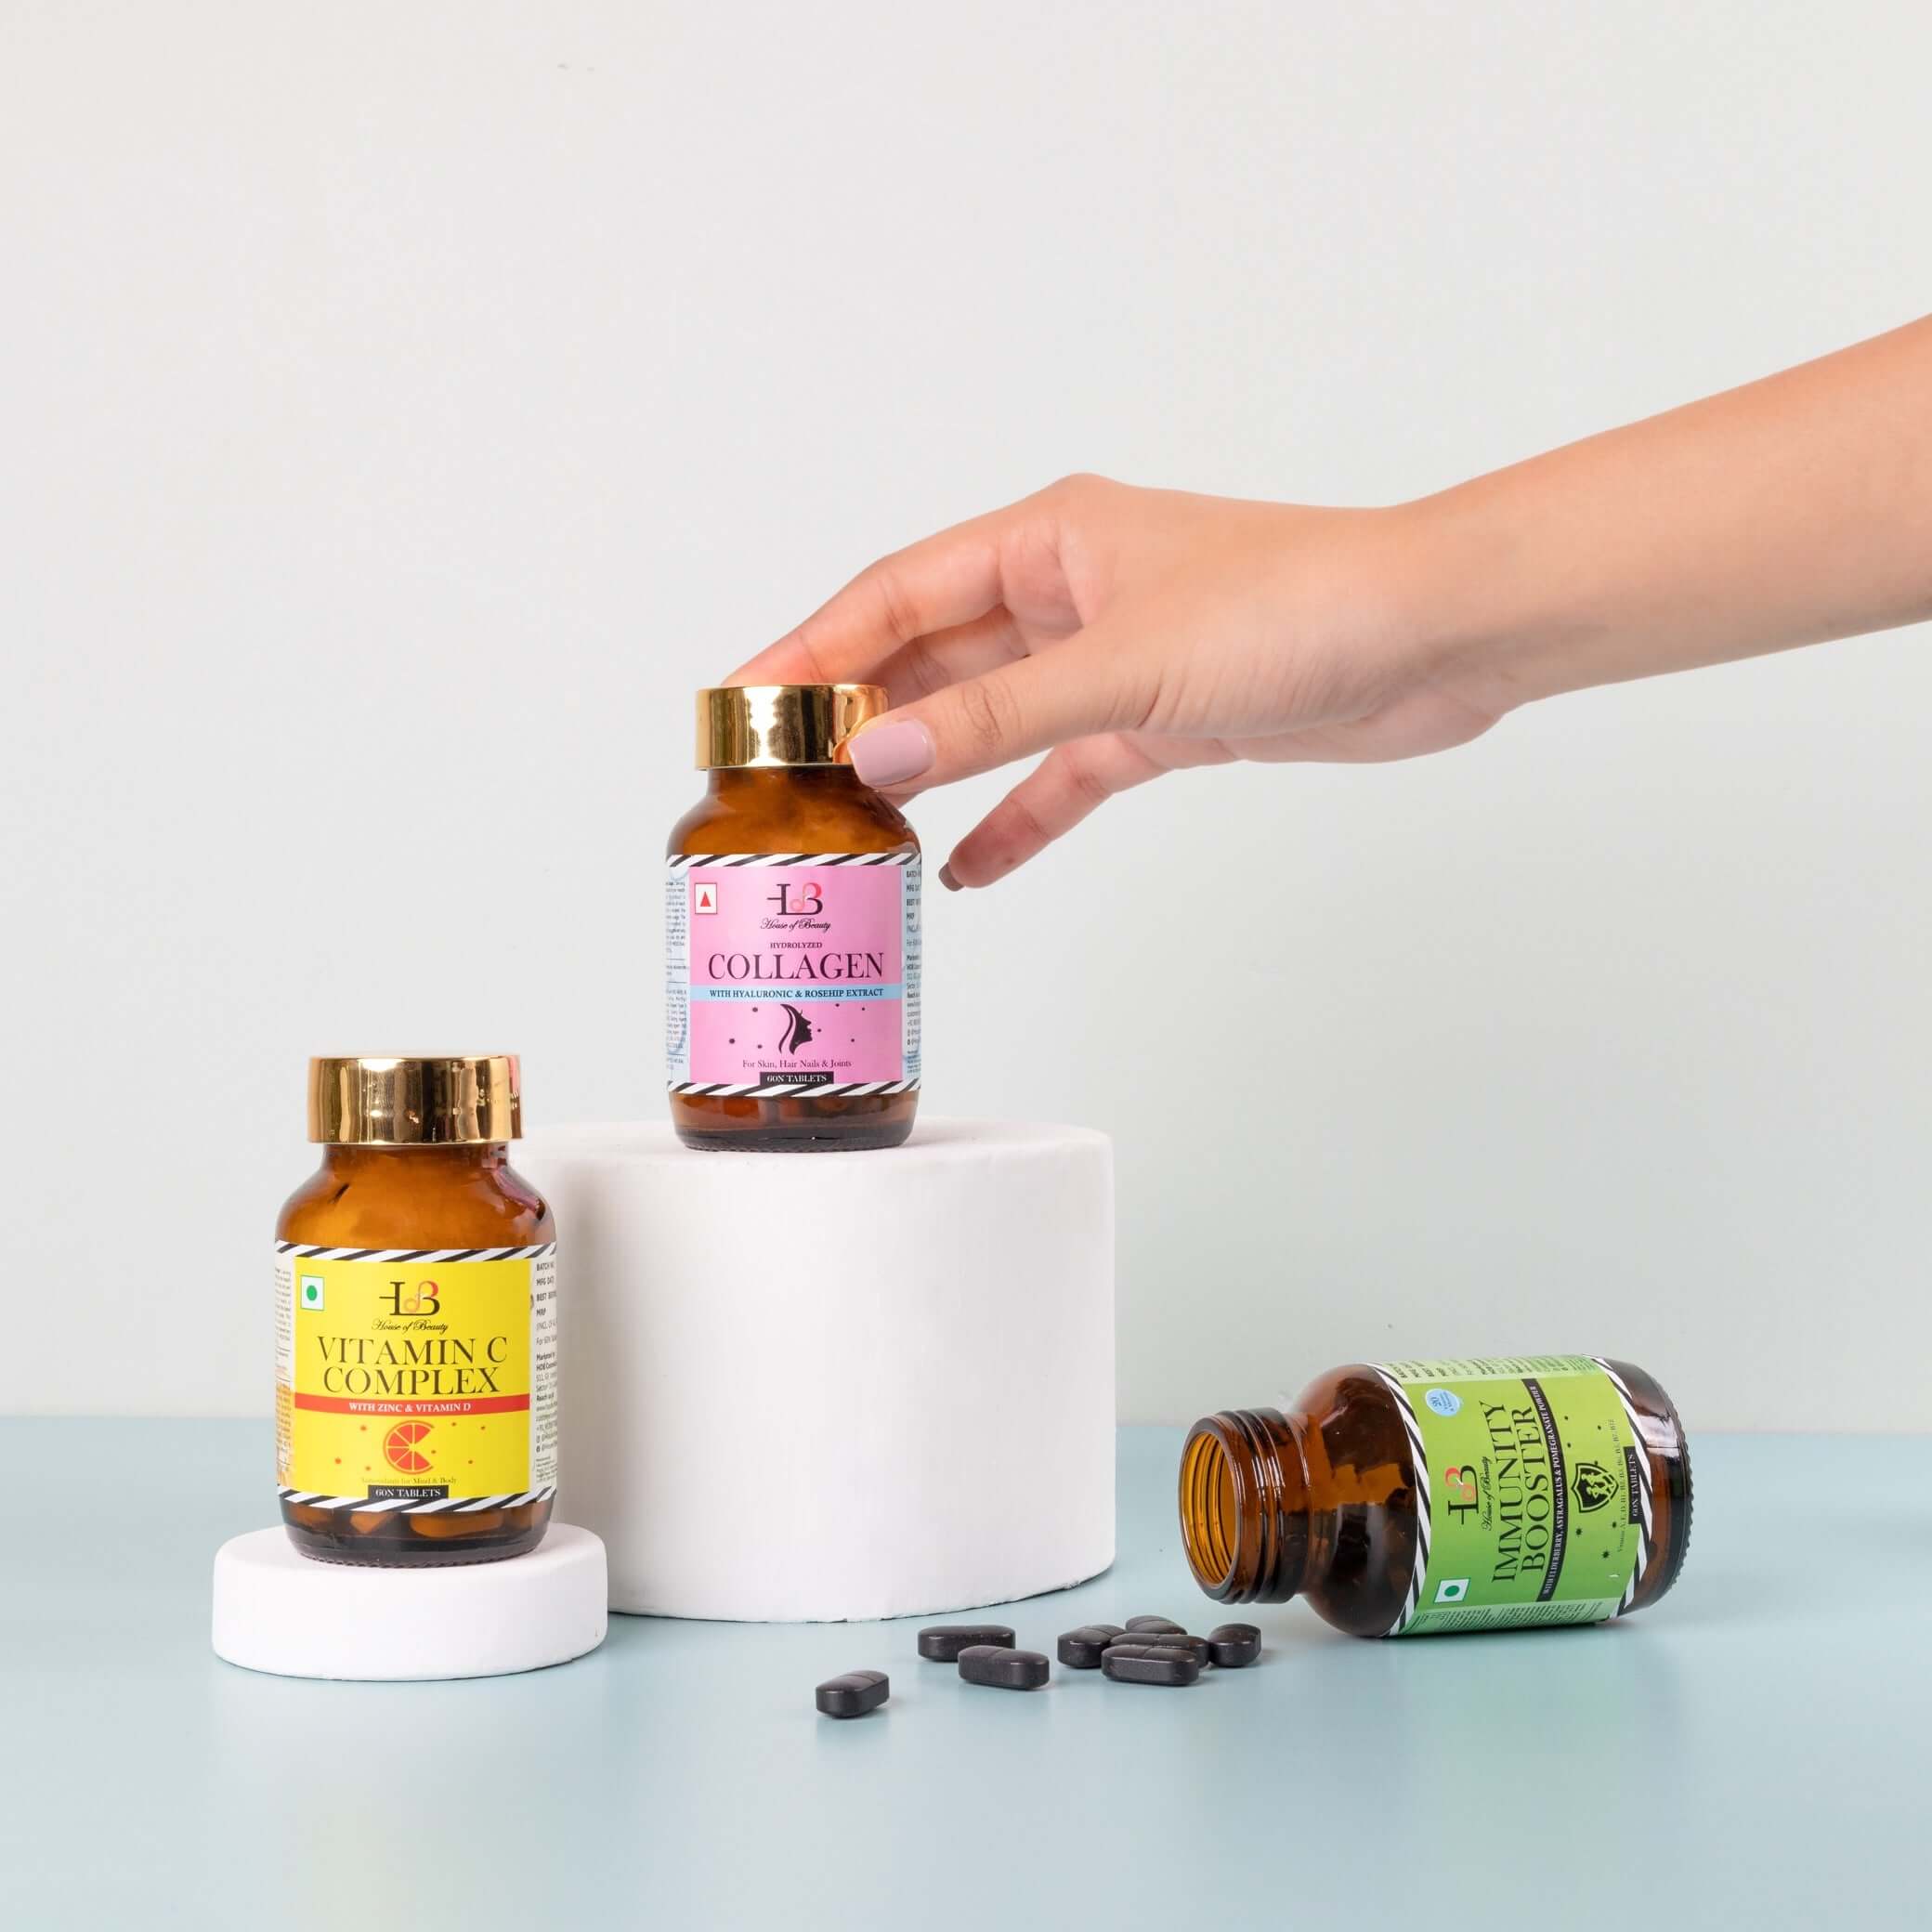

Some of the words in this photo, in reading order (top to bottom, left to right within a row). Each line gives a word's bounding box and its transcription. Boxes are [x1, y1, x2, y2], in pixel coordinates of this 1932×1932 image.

[760, 918, 788, 930] House
[789, 920, 799, 932] of
[799, 919, 831, 933] Beauty
[708, 952, 884, 980] COLLAGEN
[710, 989, 731, 998] WITH
[733, 989, 792, 999] HYALURONIC
[795, 989, 803, 998] &
[804, 989, 845, 998] ROSEHIP
[846, 988, 883, 998] EXTRACT
[742, 1060, 755, 1068] For
[757, 1060, 777, 1069] Skin,
[779, 1060, 797, 1068] Hair
[800, 1060, 820, 1068] Nails
[822, 1060, 829, 1068] &
[830, 1059, 852, 1068] Joints
[786, 1074, 828, 1082] TABLETS
[371, 1318, 401, 1331] House
[401, 1321, 413, 1334] of
[413, 1319, 449, 1335] Beauty
[317, 1336, 476, 1365] VITAMIN
[487, 1336, 507, 1363] C
[324, 1366, 501, 1395] COMPLEX
[349, 1403, 375, 1412] WITH
[377, 1403, 403, 1412] ZINC
[404, 1403, 412, 1412] &
[415, 1403, 461, 1412] VITAMIN
[463, 1403, 472, 1411] D
[1530, 1386, 1547, 1411] POWDER
[1540, 1411, 1560, 1468] POMEGRANATE
[1480, 1456, 1493, 1486] Beauty
[1628, 1454, 1638, 1495] TABLETS
[396, 1489, 441, 1497] TABLETS
[1479, 1401, 1523, 1583] IMMUNITY
[1483, 1491, 1495, 1504] of
[1511, 1406, 1550, 1572] BOOSTER
[1554, 1476, 1564, 1529] ASTRAGALUS
[1481, 1505, 1493, 1531] House
